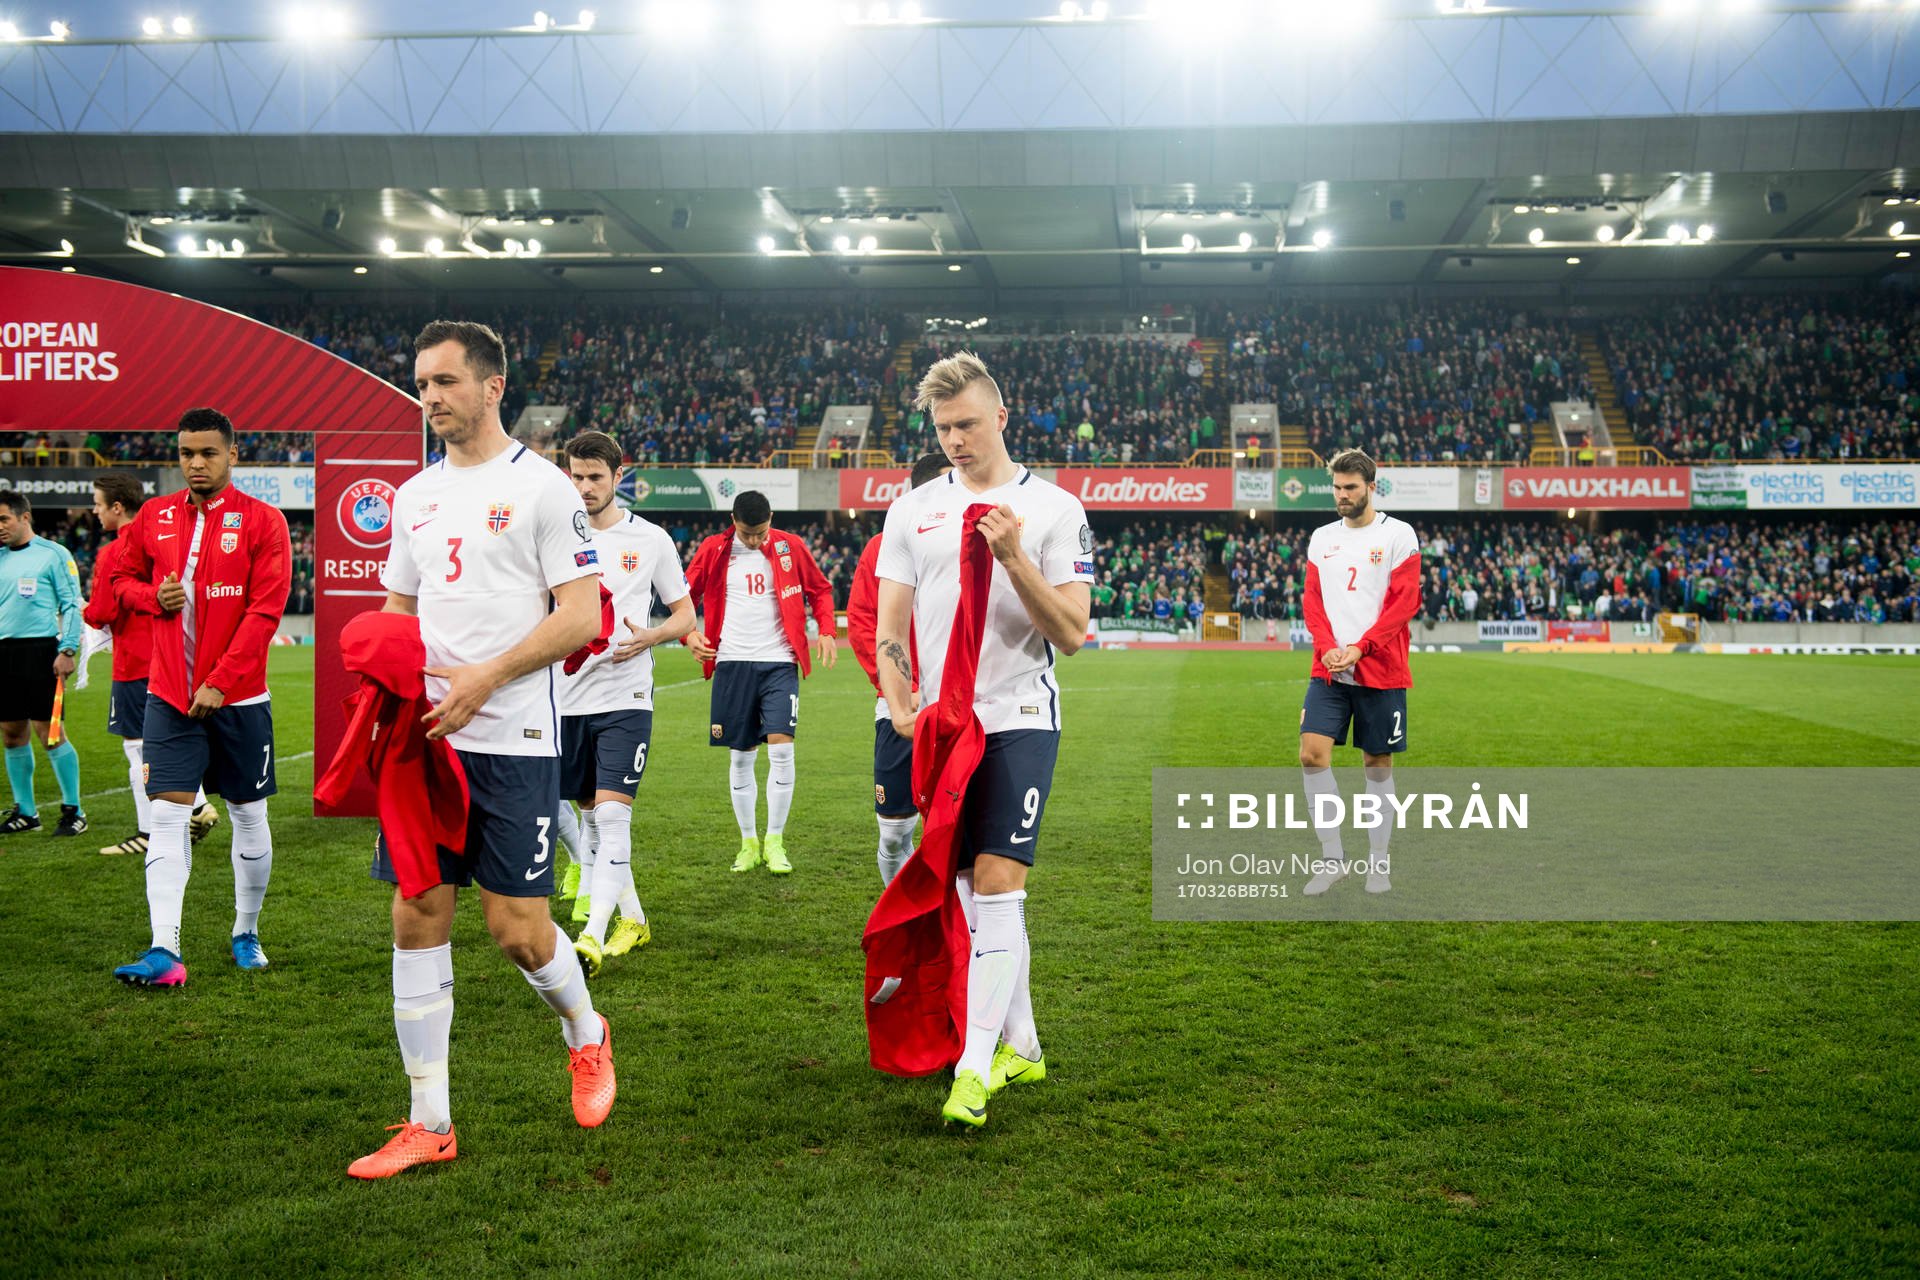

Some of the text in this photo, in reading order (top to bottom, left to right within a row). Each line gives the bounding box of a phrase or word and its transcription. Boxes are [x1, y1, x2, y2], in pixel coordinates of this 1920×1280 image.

[0, 322, 98, 348] OPEAN
[0, 351, 119, 381] LIFIERS
[1080, 476, 1208, 502] Ladbrokes
[1527, 478, 1685, 498] VAUXHALL
[1750, 470, 1914, 487] electric electric
[350, 484, 391, 500] UEFA
[1763, 486, 1915, 503] Ireland Ireland
[446, 538, 462, 582] 3
[745, 573, 765, 596] 18
[1347, 567, 1357, 591] 2
[1482, 624, 1537, 636] NORN IRON
[1393, 711, 1402, 737] 2
[263, 744, 270, 776] 7
[633, 743, 647, 773] 6
[1021, 787, 1040, 829] 9
[534, 817, 551, 863] 3
